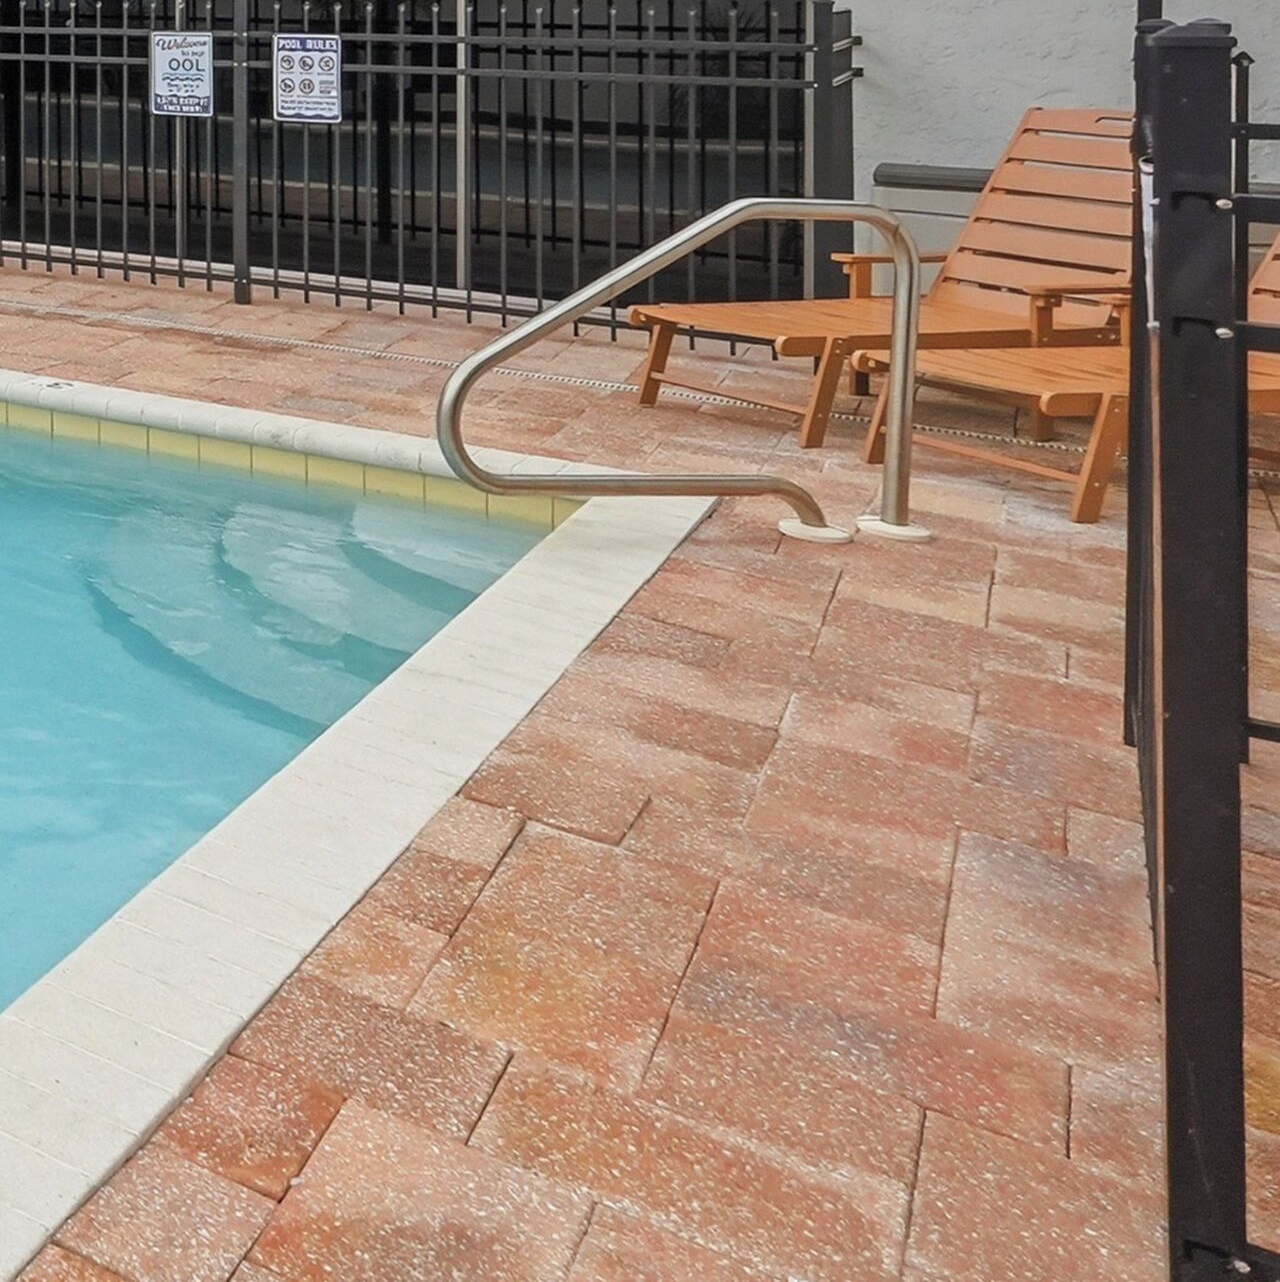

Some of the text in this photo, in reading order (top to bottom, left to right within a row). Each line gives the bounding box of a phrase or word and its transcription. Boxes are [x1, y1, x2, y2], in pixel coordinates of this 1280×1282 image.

[278, 39, 337, 50] POOL RULES
[168, 58, 206, 71] OOL
